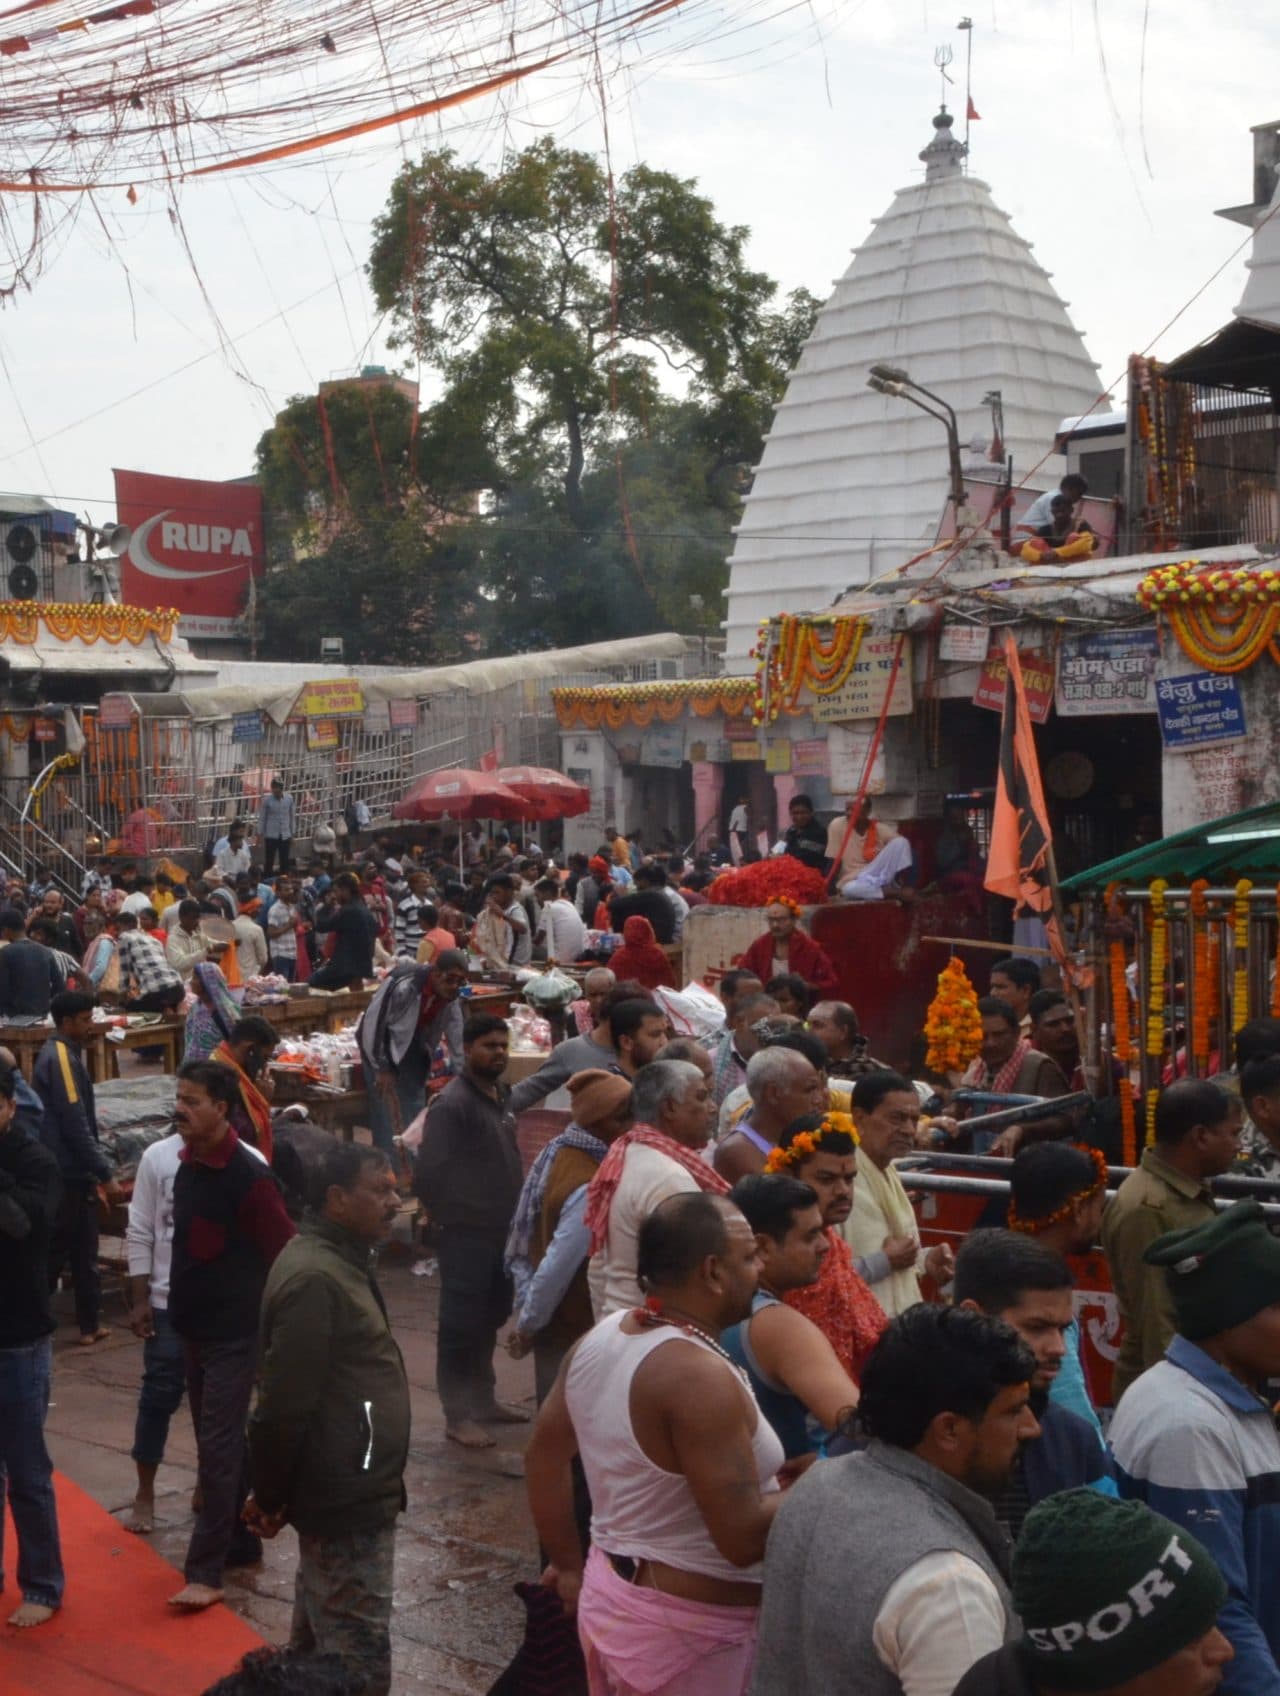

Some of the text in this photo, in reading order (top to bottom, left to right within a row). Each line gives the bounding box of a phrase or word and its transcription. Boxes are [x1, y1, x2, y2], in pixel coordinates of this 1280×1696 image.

[162, 520, 253, 556] RUPA
[1065, 653, 1146, 677] भीम पंडा
[1198, 672, 1235, 694] पंडा
[1027, 1535, 1192, 1651] SPORT
